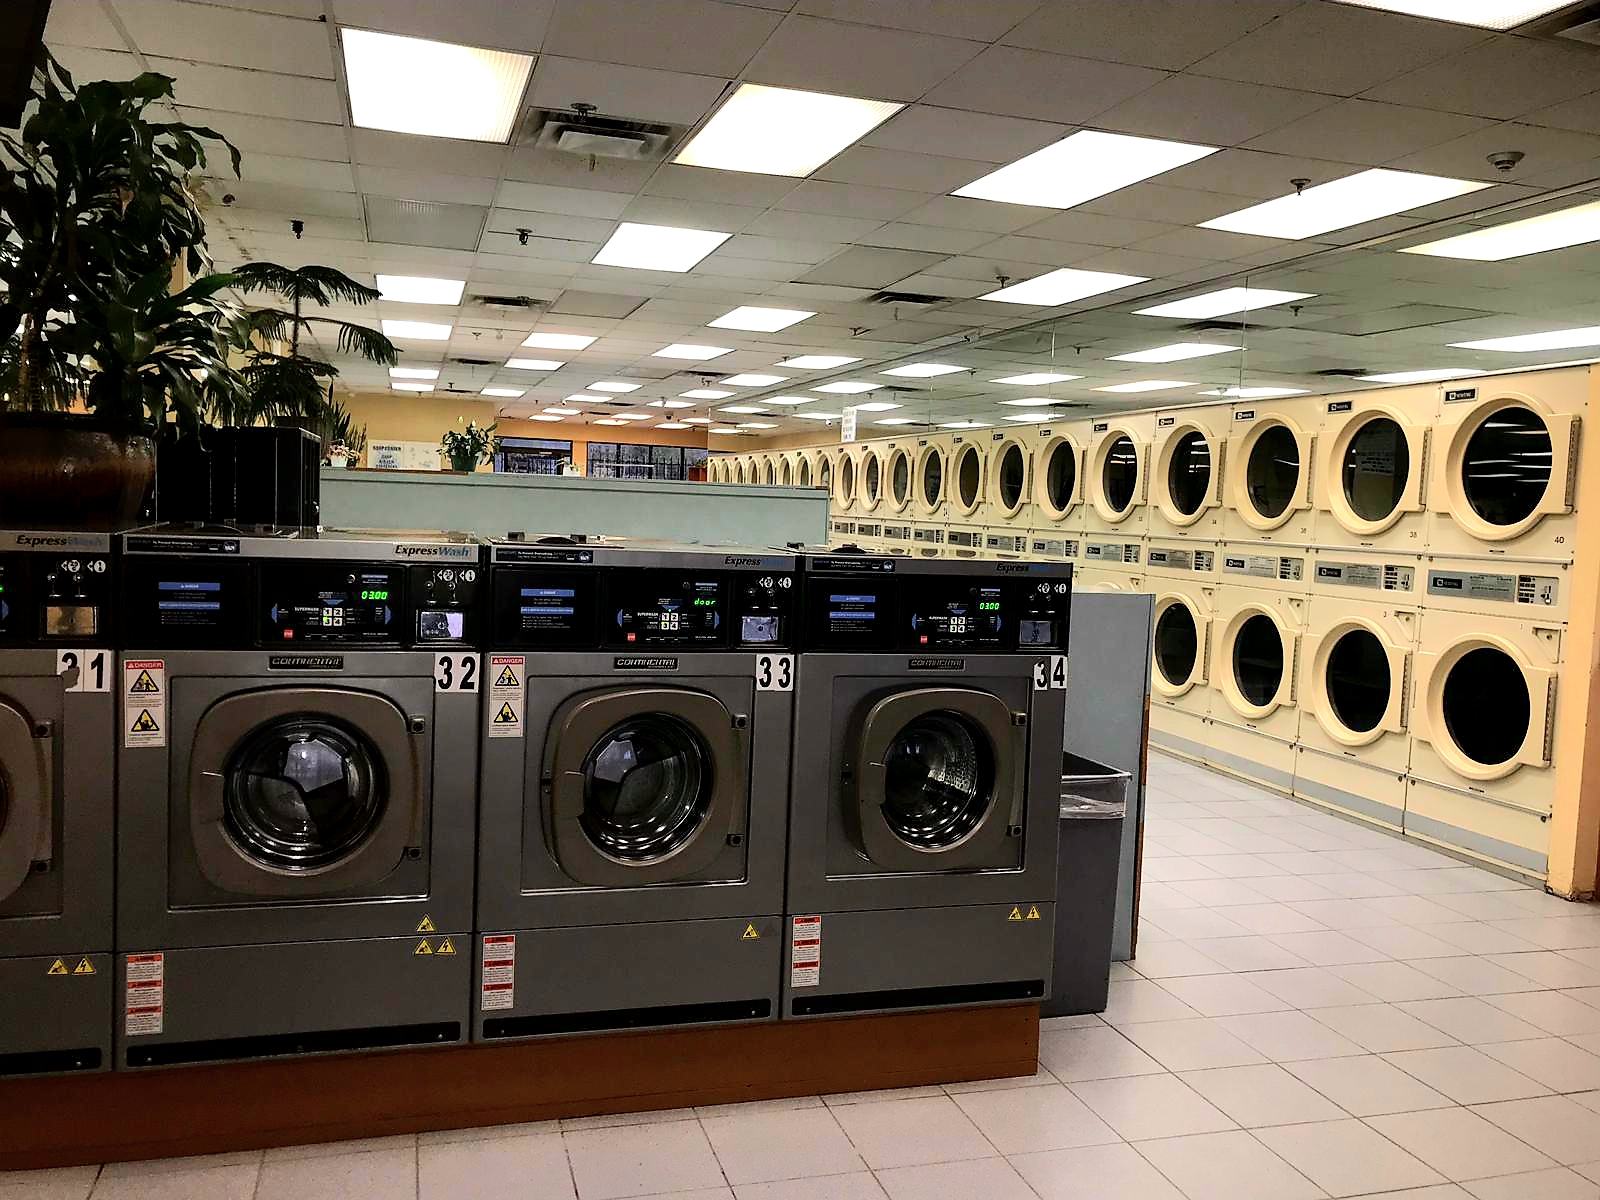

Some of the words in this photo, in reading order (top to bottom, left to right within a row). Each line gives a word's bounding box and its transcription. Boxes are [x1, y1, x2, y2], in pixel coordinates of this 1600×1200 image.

[694, 598, 716, 606] door
[438, 655, 475, 690] 32
[759, 656, 790, 688] 33
[1037, 657, 1065, 687] 34
